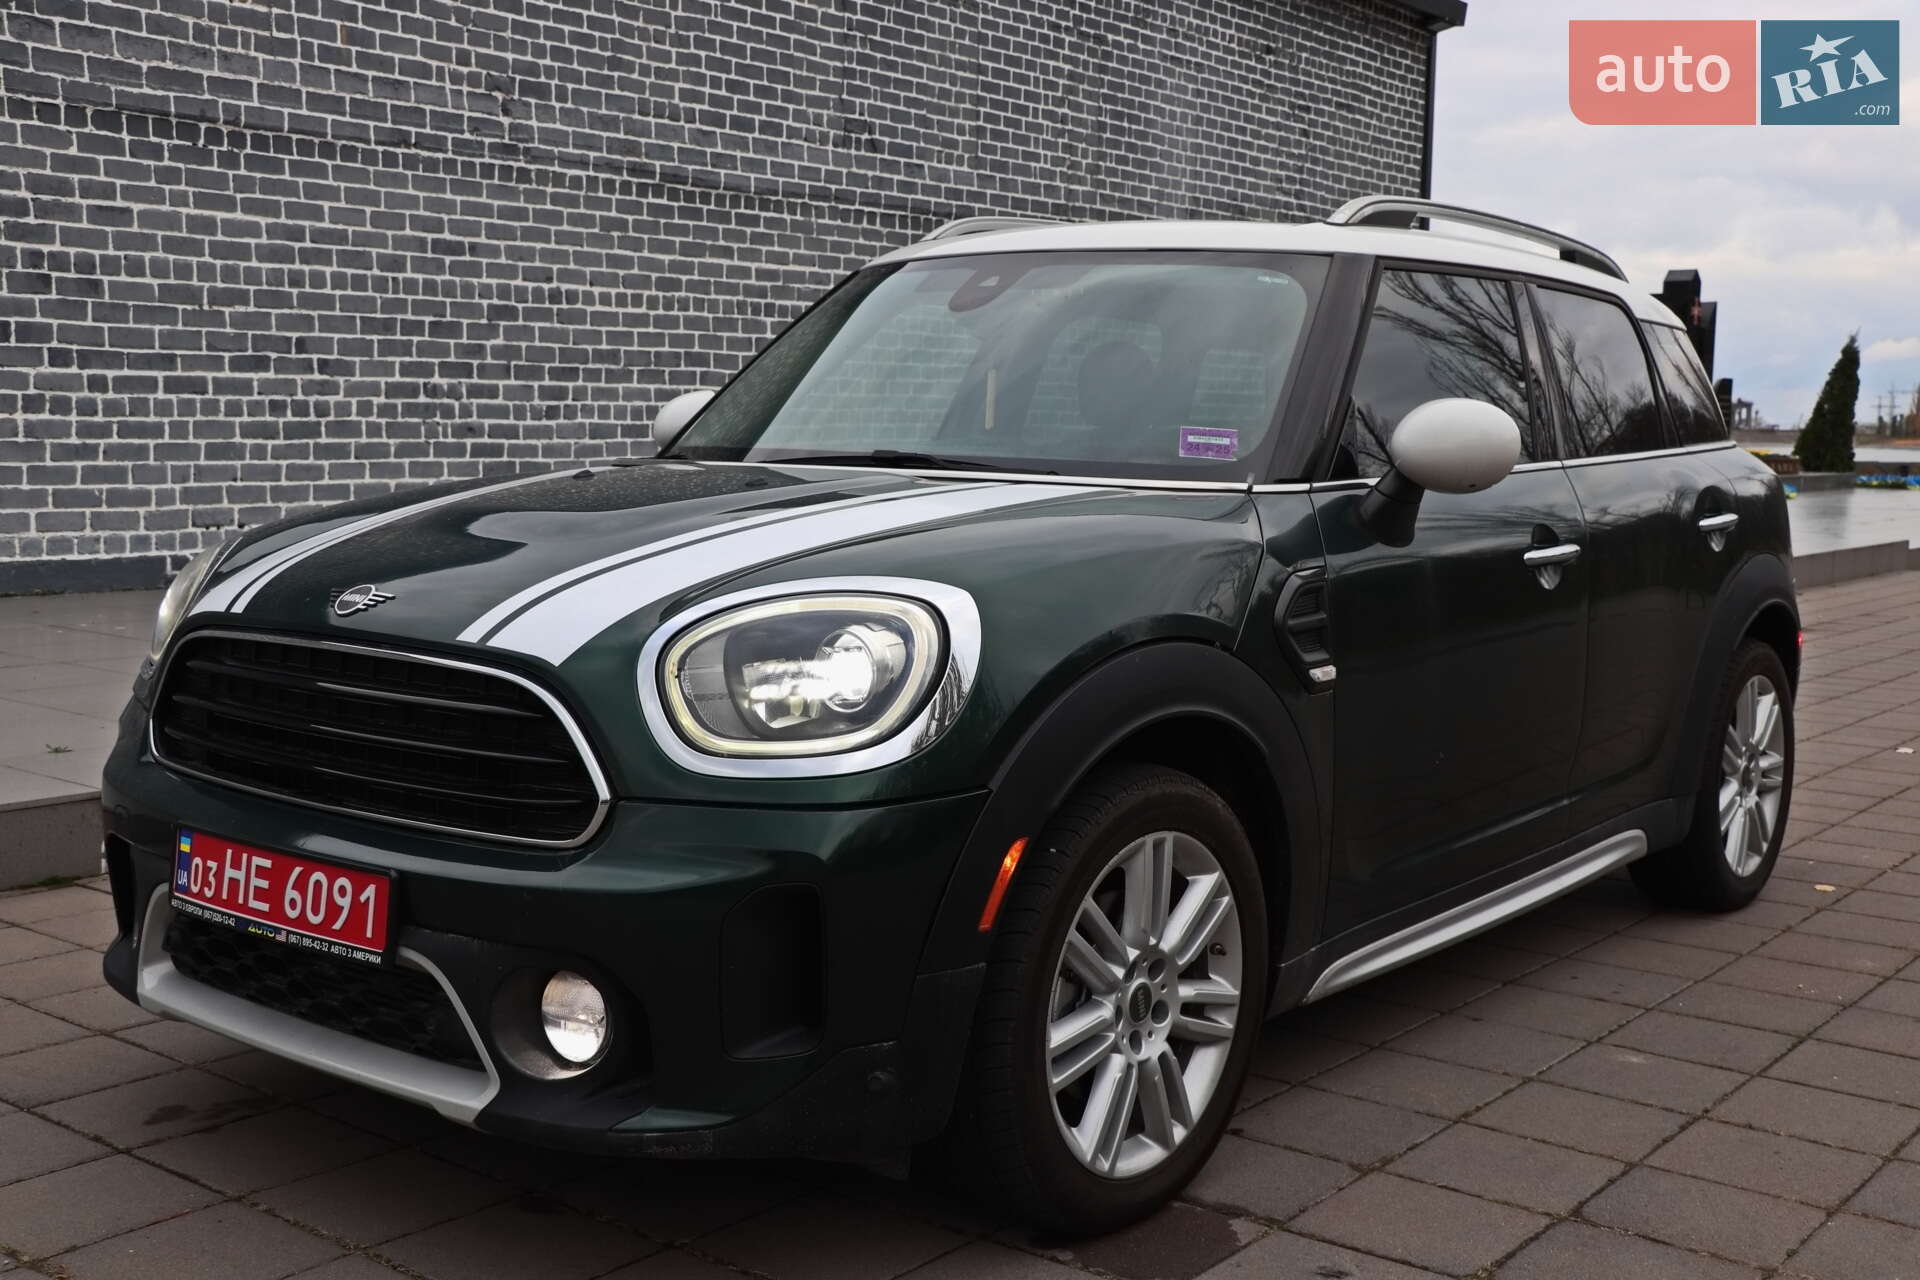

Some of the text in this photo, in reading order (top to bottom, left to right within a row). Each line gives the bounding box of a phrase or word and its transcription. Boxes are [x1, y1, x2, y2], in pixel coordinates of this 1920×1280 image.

[177, 869, 188, 886] UA
[284, 866, 376, 938] 6091
[352, 949, 382, 965] АМЕРИКИ
